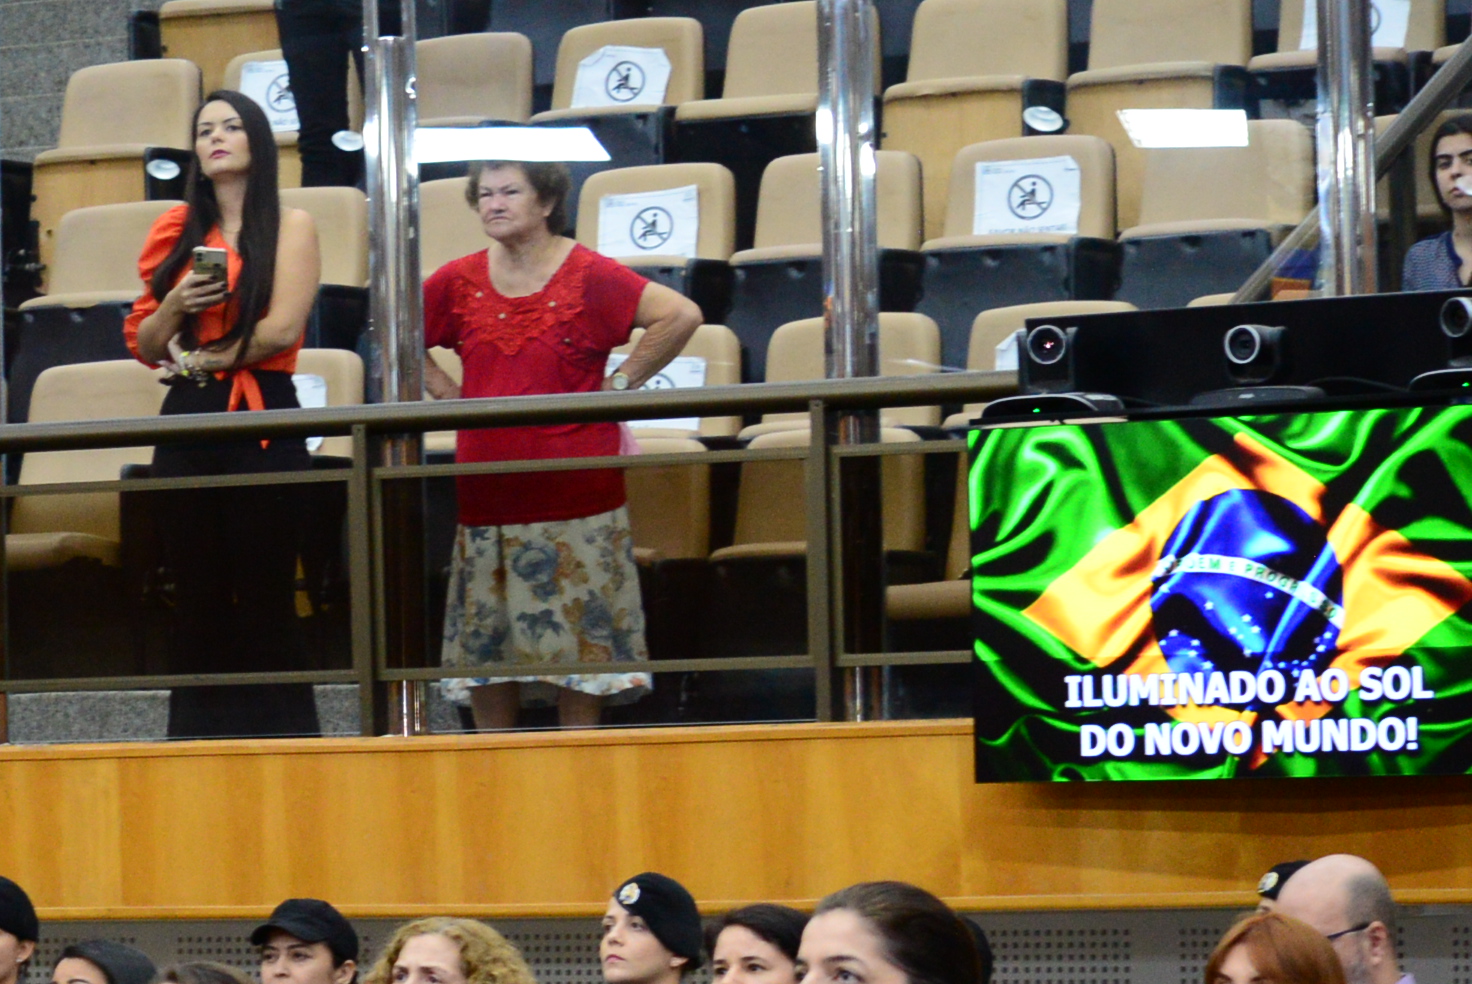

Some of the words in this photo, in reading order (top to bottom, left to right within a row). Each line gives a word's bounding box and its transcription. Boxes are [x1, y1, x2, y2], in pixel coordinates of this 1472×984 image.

[1064, 669, 1286, 708] ILUMINADO
[1294, 666, 1350, 702] AO
[1358, 665, 1435, 701] SOL
[1080, 723, 1135, 757] DO
[1144, 719, 1252, 756] NOVO
[1261, 716, 1418, 753] MUNDO!
